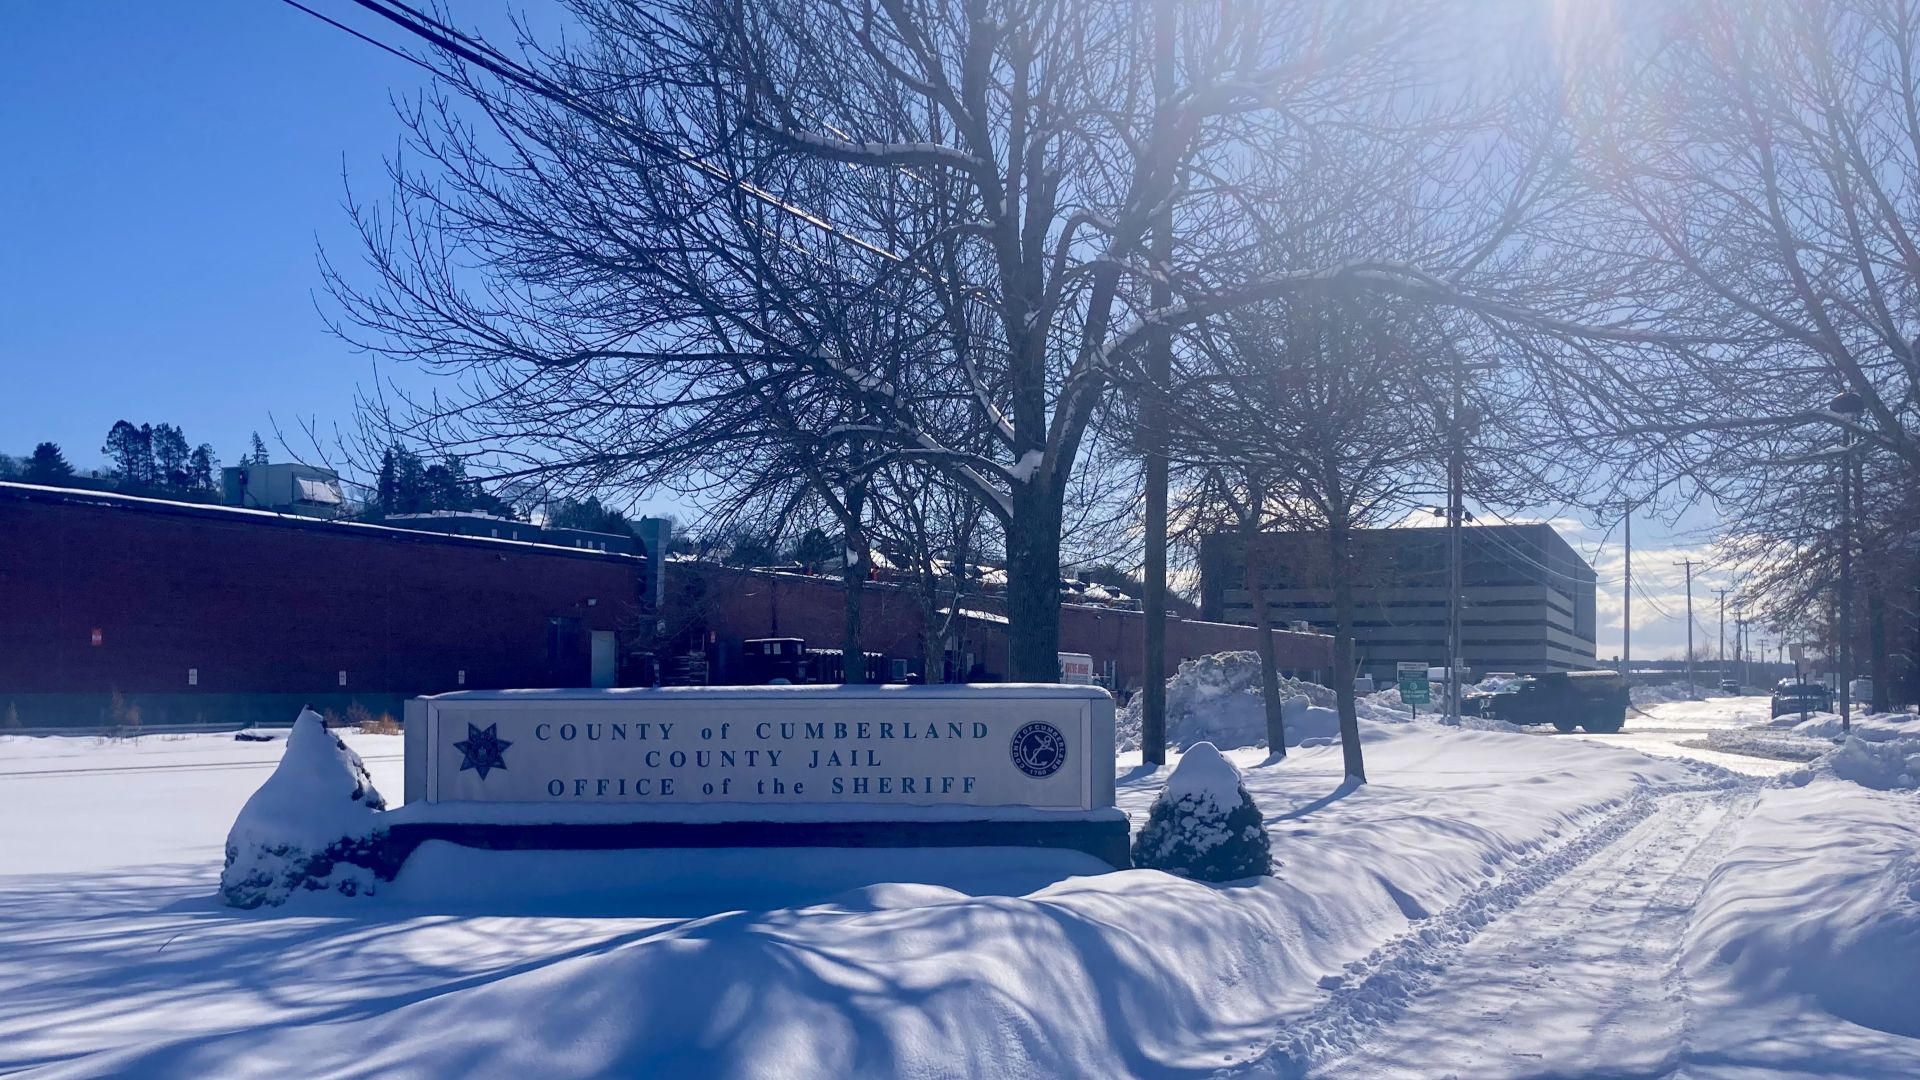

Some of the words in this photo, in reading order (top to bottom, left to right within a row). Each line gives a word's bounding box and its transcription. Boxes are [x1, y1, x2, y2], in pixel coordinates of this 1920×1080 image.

[536, 723, 674, 741] COUNTY
[701, 722, 730, 740] of
[755, 722, 988, 740] CUMBERLAND
[1014, 733, 1026, 768] COUNTY
[1022, 725, 1033, 735] OF
[1034, 725, 1064, 770] CUMBERLAND
[645, 750, 782, 768] COUNTY
[808, 749, 881, 769] JAIL
[547, 778, 675, 797] OFFICE
[702, 777, 732, 795] of
[757, 777, 804, 795] the
[831, 776, 976, 795] SHERIFF
